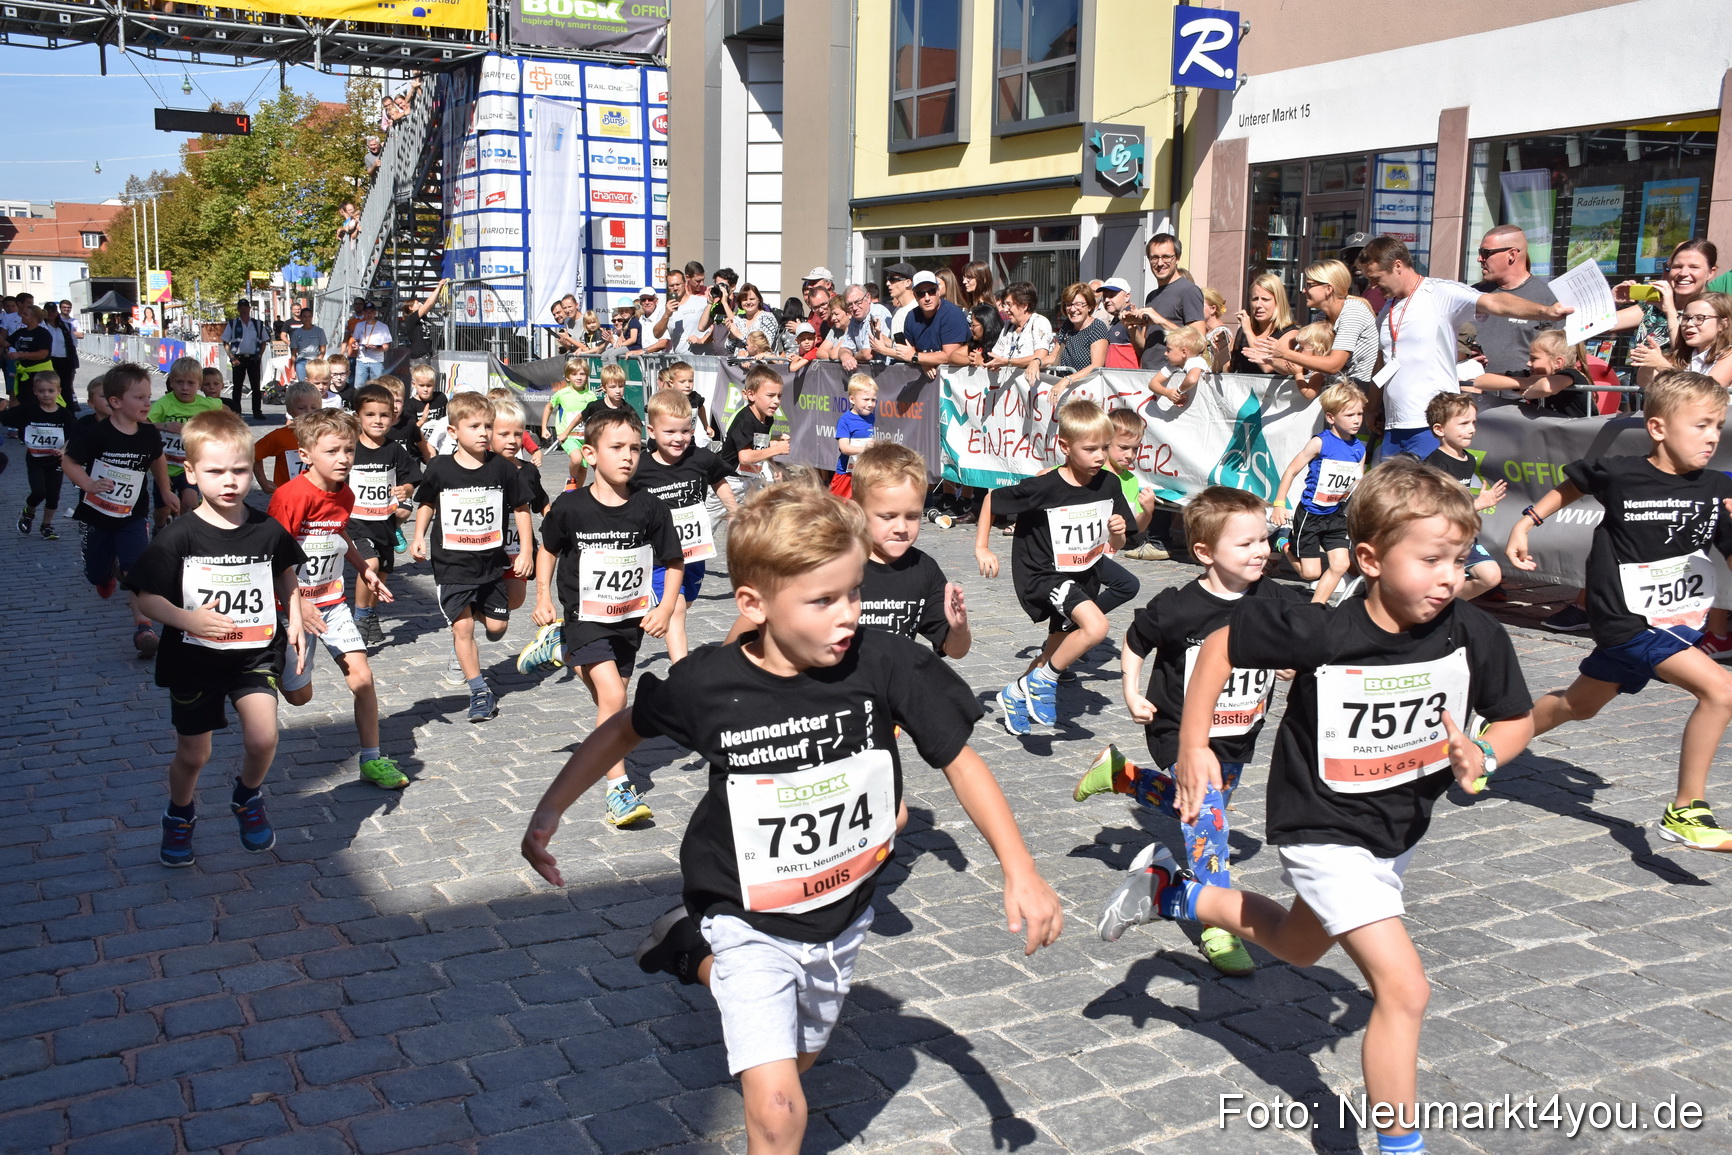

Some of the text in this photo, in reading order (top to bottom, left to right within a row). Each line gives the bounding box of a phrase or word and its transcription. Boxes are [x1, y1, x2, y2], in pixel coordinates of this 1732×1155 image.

[521, 0, 627, 24] BOCK
[521, 16, 628, 34] inspired by smart concepts
[554, 73, 571, 81] CODE
[554, 79, 575, 88] CLINIC
[1238, 103, 1311, 128] Unterer Markt 15
[236, 117, 247, 133] 4
[1576, 195, 1620, 207] Radfahren
[799, 394, 830, 412] OFFICE
[880, 400, 925, 420] LOUNGE
[1004, 388, 1048, 422] UNS
[31, 434, 59, 446] 7447
[102, 451, 140, 460] Neumarkter
[107, 469, 132, 481] BOCK
[358, 484, 392, 501] 7566
[648, 480, 689, 493] Neumarkter
[99, 501, 119, 512] Julian
[1623, 500, 1692, 510] Neumarkter
[451, 506, 495, 526] 7435
[1623, 510, 1679, 522] Stadtlauf
[457, 536, 492, 544] Johannes
[575, 530, 630, 540] Neumarkter
[1060, 518, 1103, 545] 7111
[304, 541, 334, 551] BOCK
[577, 540, 619, 550] Stadtlauf
[604, 554, 637, 565] BOCK
[212, 572, 251, 584] BOCK
[1651, 560, 1692, 578] BOCK
[592, 567, 644, 592] 7423
[1639, 574, 1704, 609] 7502
[197, 588, 265, 616] 7043
[606, 603, 631, 615] Oliver
[1363, 672, 1431, 692] BOCK
[1342, 691, 1447, 740] 7573
[720, 714, 829, 749] Neumarkter
[728, 738, 810, 767] Stadtlauf
[1353, 736, 1427, 754] PARTL Neumarkt
[1354, 757, 1417, 778] Lukas
[777, 773, 849, 804] BOCK
[757, 792, 873, 859] 7374
[744, 851, 756, 861] B2
[776, 844, 856, 874] PARTL Neumarkt
[802, 867, 851, 898] Louis
